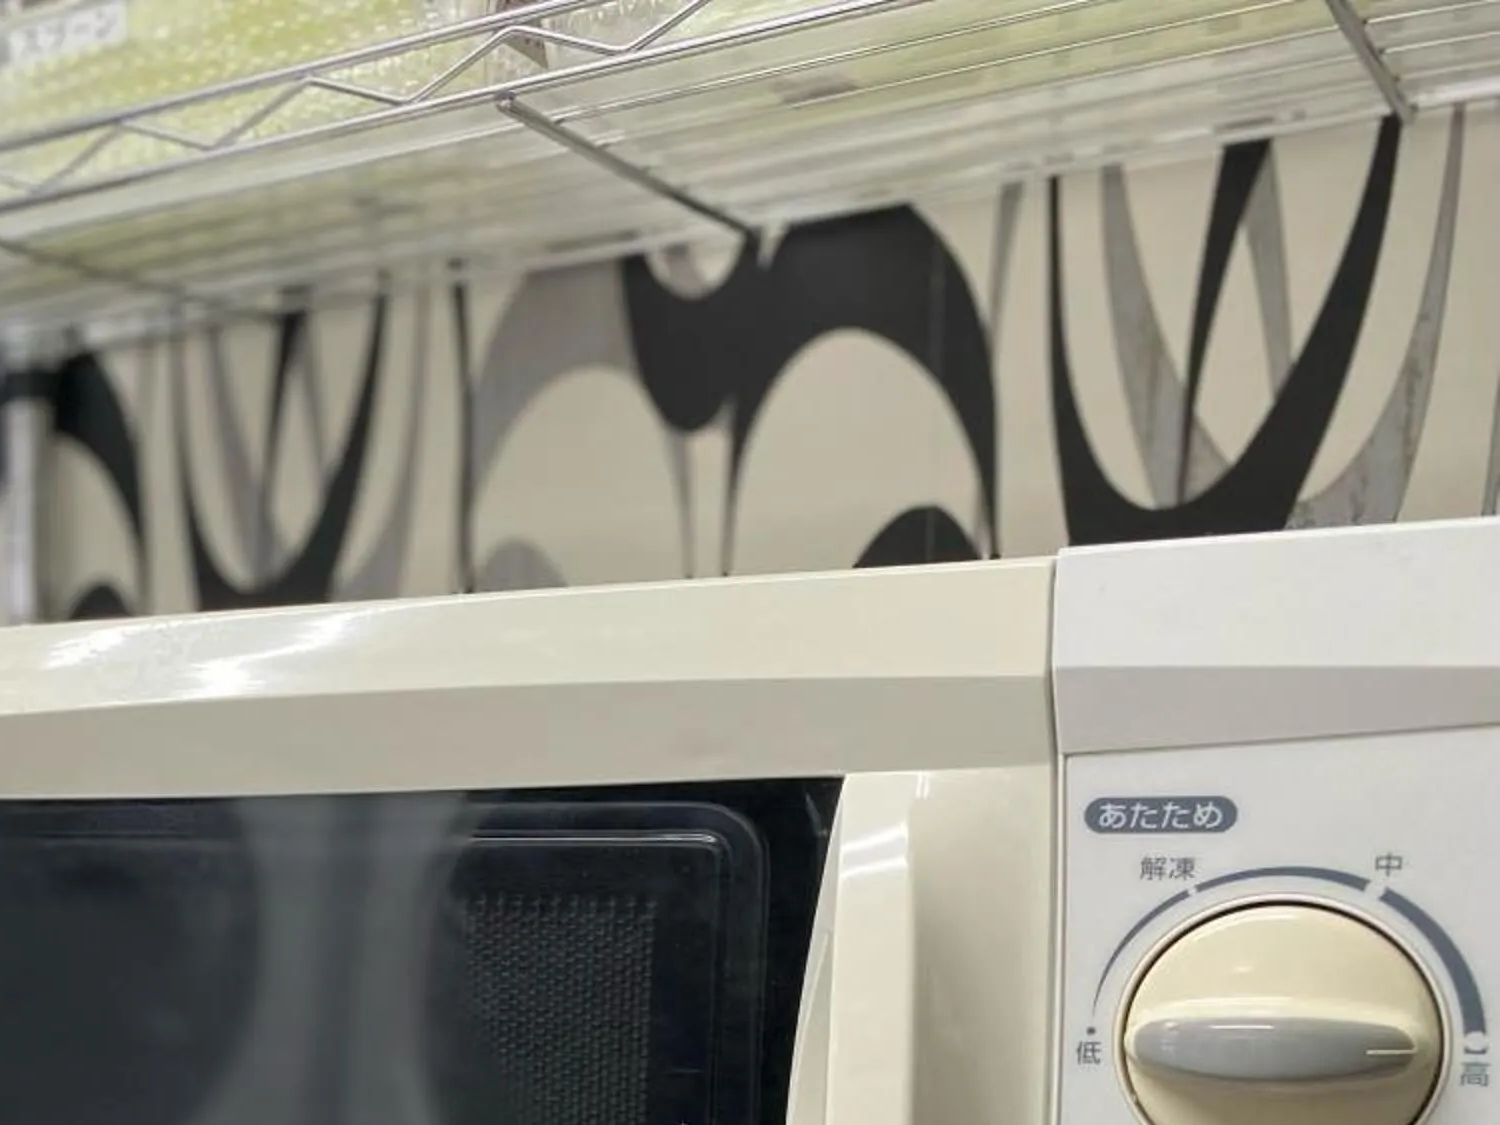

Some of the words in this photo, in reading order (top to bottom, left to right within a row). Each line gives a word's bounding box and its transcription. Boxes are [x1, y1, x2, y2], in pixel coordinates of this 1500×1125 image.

[1098, 801, 1224, 830] あたため
[1140, 856, 1196, 881] 解凍
[1374, 853, 1402, 878] 中
[1076, 1041, 1101, 1066] 低
[1460, 1062, 1491, 1087] 高
